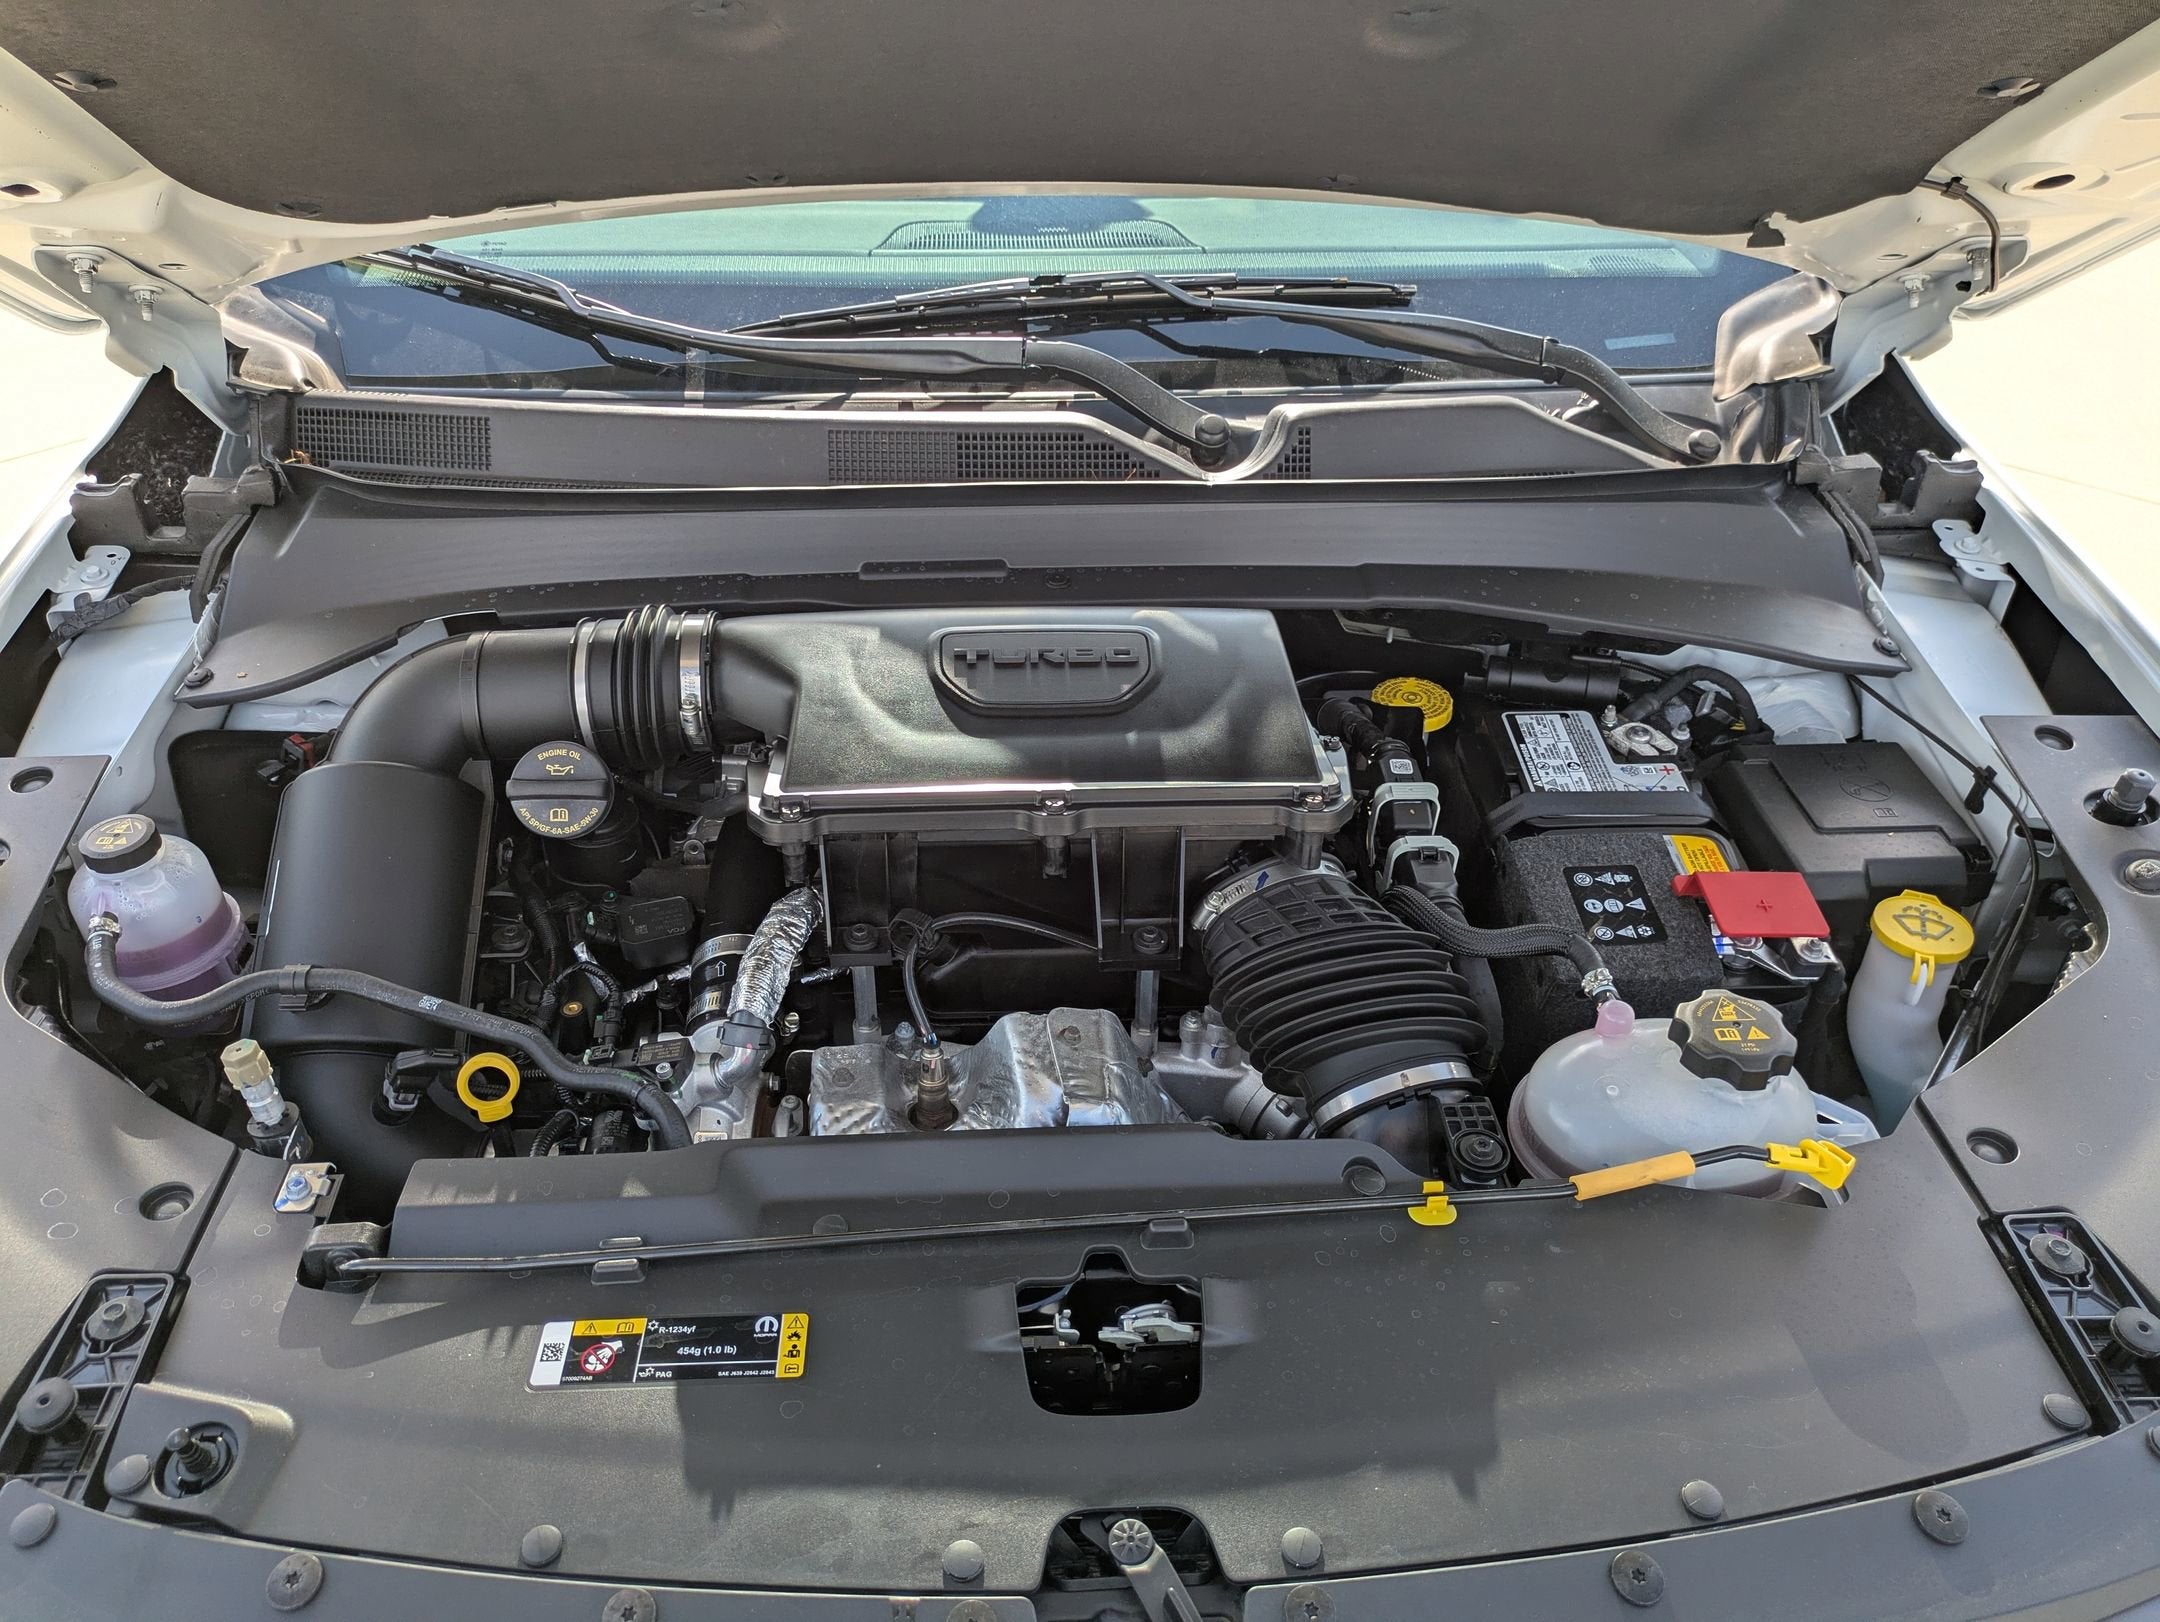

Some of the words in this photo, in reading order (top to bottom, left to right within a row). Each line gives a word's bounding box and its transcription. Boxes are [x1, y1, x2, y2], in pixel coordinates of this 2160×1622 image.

[954, 648, 1139, 664] TURBO
[537, 749, 568, 761] ENGINE
[569, 750, 582, 761] OIL
[520, 807, 532, 820] API
[658, 1325, 697, 1334] R-1234yf
[676, 1346, 702, 1356] 454g
[703, 1346, 722, 1356] (1.0
[724, 1345, 737, 1355] lb)
[655, 1370, 673, 1378] PAG
